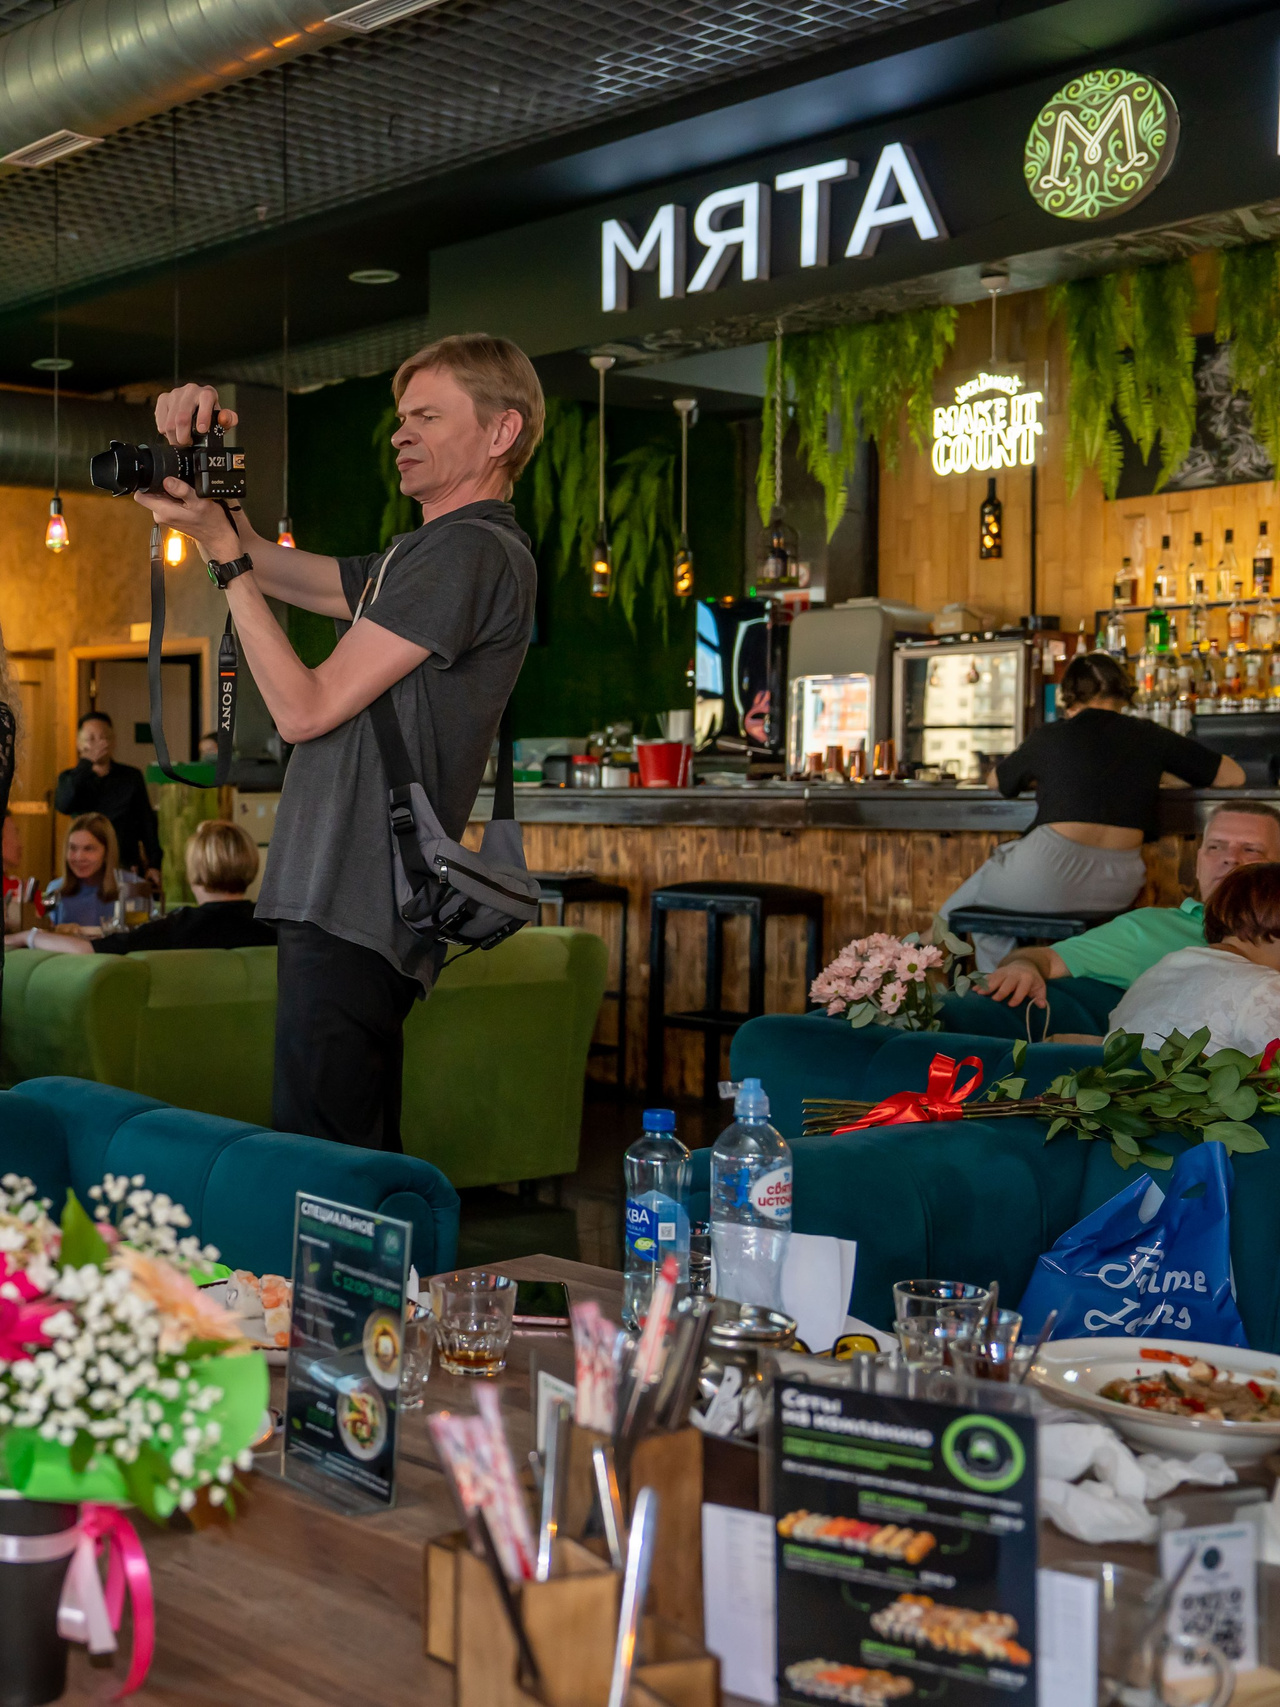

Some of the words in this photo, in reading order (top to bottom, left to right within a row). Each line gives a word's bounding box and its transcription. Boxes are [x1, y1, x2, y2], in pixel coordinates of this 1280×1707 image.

[601, 141, 944, 313] МЯТА
[933, 397, 1007, 439] MAKE
[1010, 391, 1043, 428] IT
[931, 422, 1043, 476] COUNT
[221, 681, 233, 732] SONY
[300, 1201, 376, 1237] СПЕЦИАЛЬНОЕ
[626, 1207, 650, 1225] КВА
